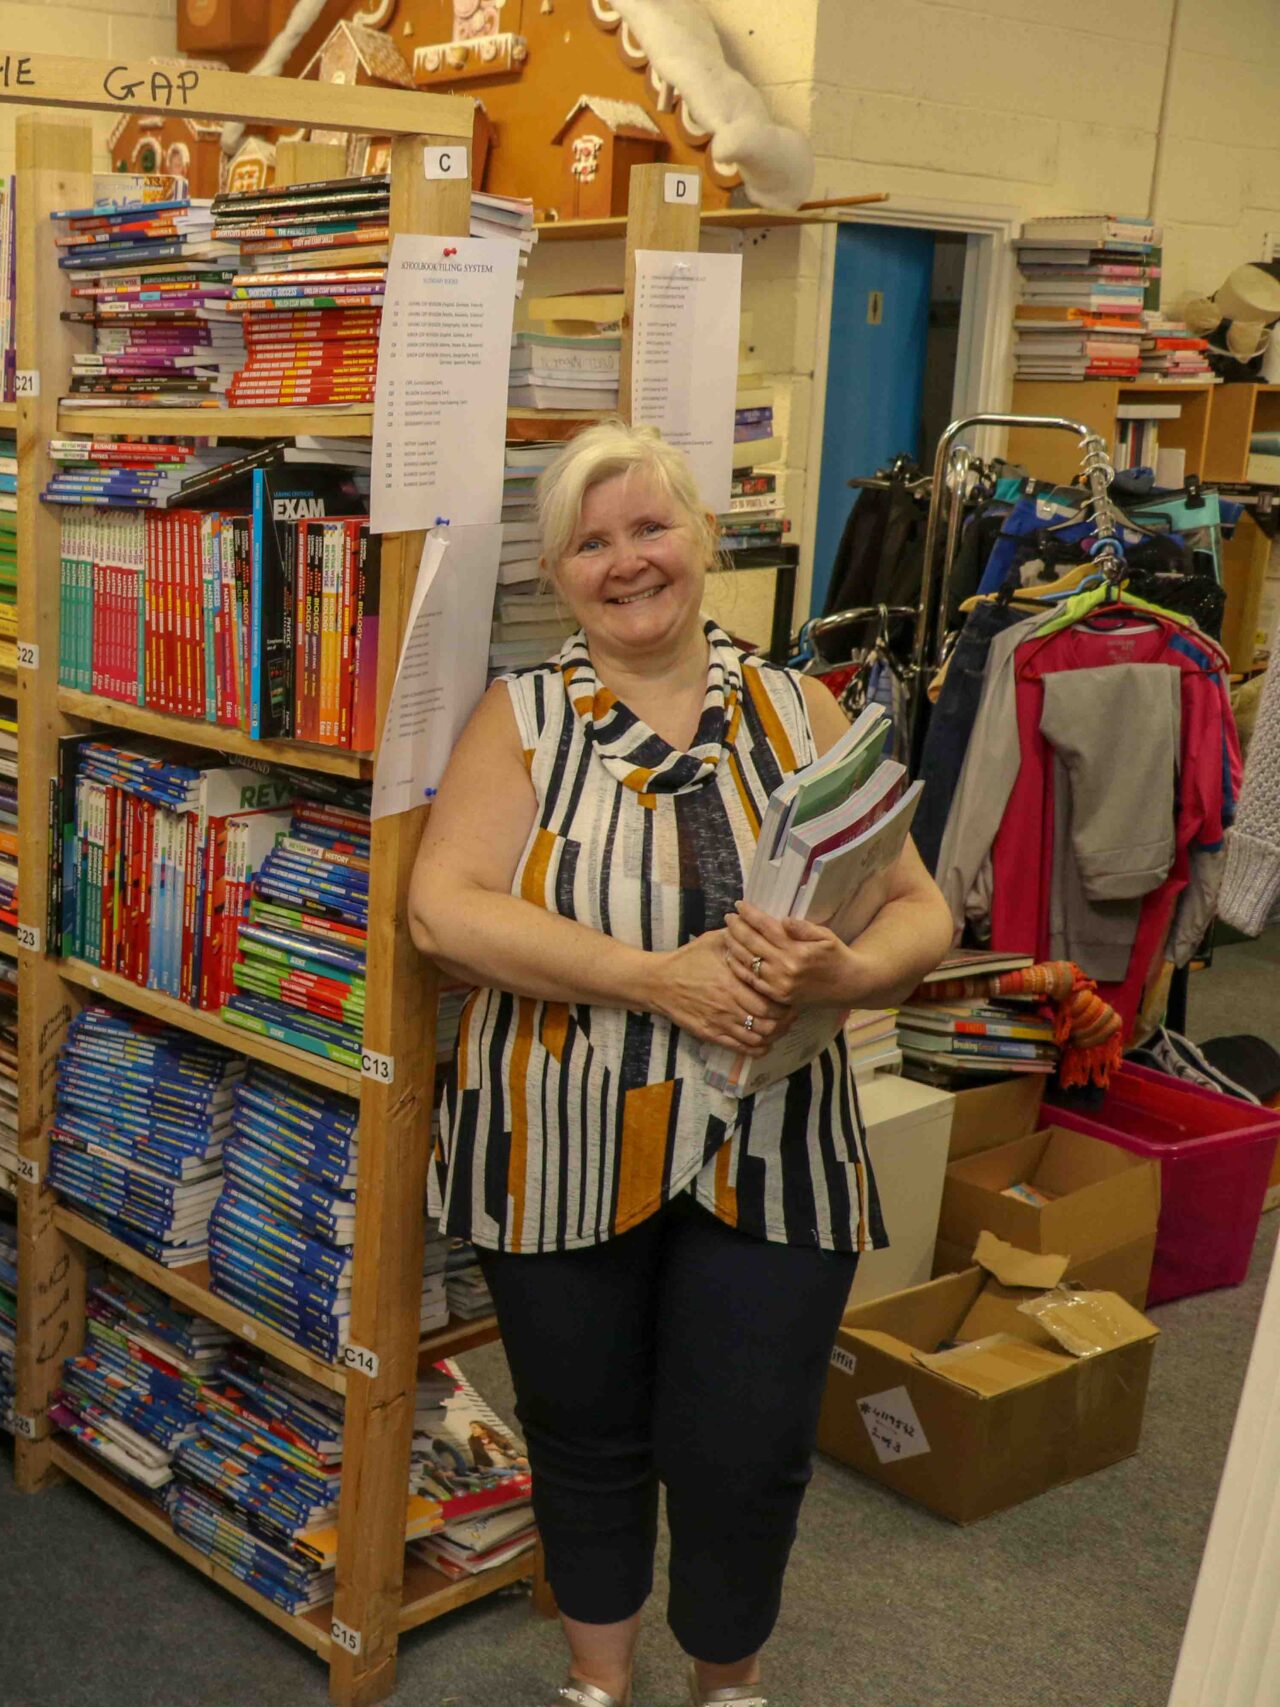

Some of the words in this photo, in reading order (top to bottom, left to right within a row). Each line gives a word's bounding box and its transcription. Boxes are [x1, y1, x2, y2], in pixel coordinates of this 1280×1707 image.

[104, 66, 200, 106] GAP
[439, 153, 451, 172] C
[676, 180, 686, 197] D
[438, 263, 462, 272] FILING
[464, 264, 493, 273] SYSTEM
[274, 499, 325, 520] EXAM
[325, 853, 349, 863] HISTORY
[362, 1054, 389, 1078] C13
[344, 1347, 374, 1371] C14
[331, 1622, 356, 1649] C15
